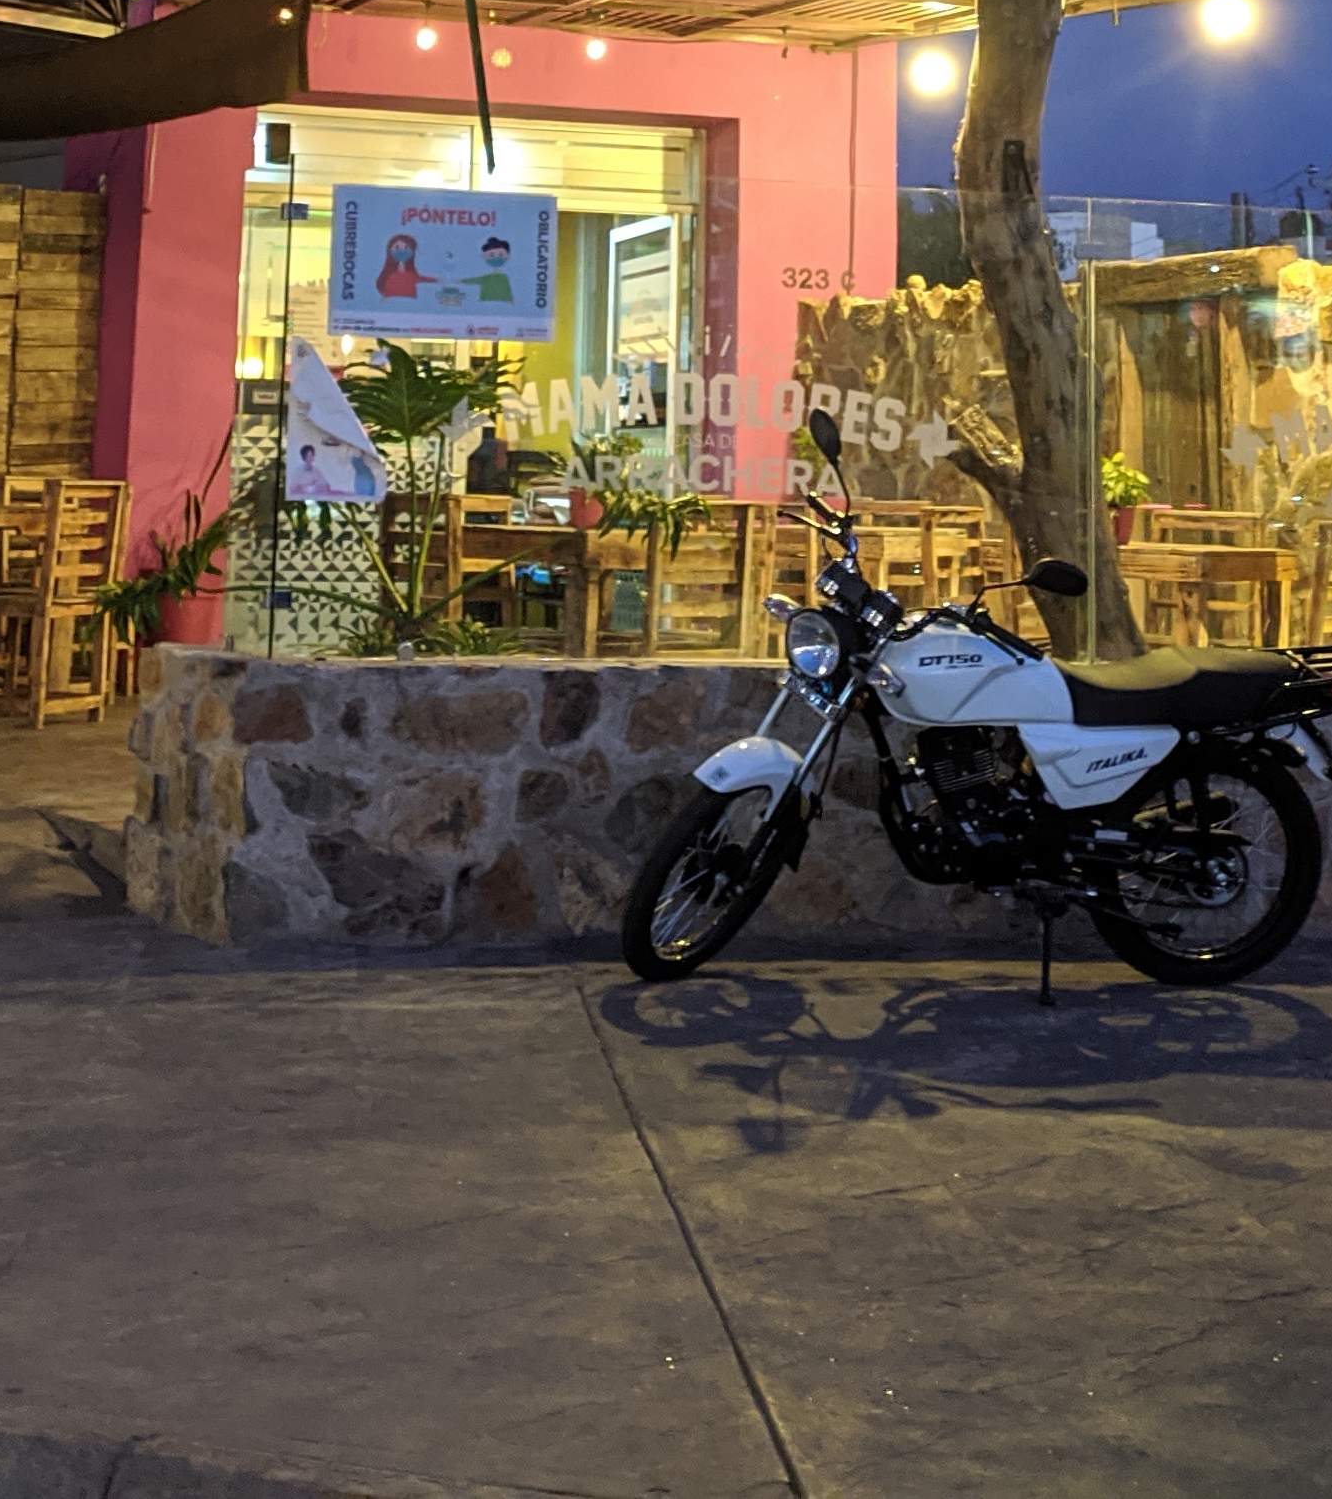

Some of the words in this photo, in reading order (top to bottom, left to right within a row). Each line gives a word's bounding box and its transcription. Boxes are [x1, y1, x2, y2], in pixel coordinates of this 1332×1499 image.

[400, 206, 497, 227] ¡PÓNTELO!
[341, 200, 359, 301] CUBREBOCAS
[781, 267, 830, 290] 323
[560, 454, 847, 498] ARRACHERA
[918, 654, 983, 668] DT150
